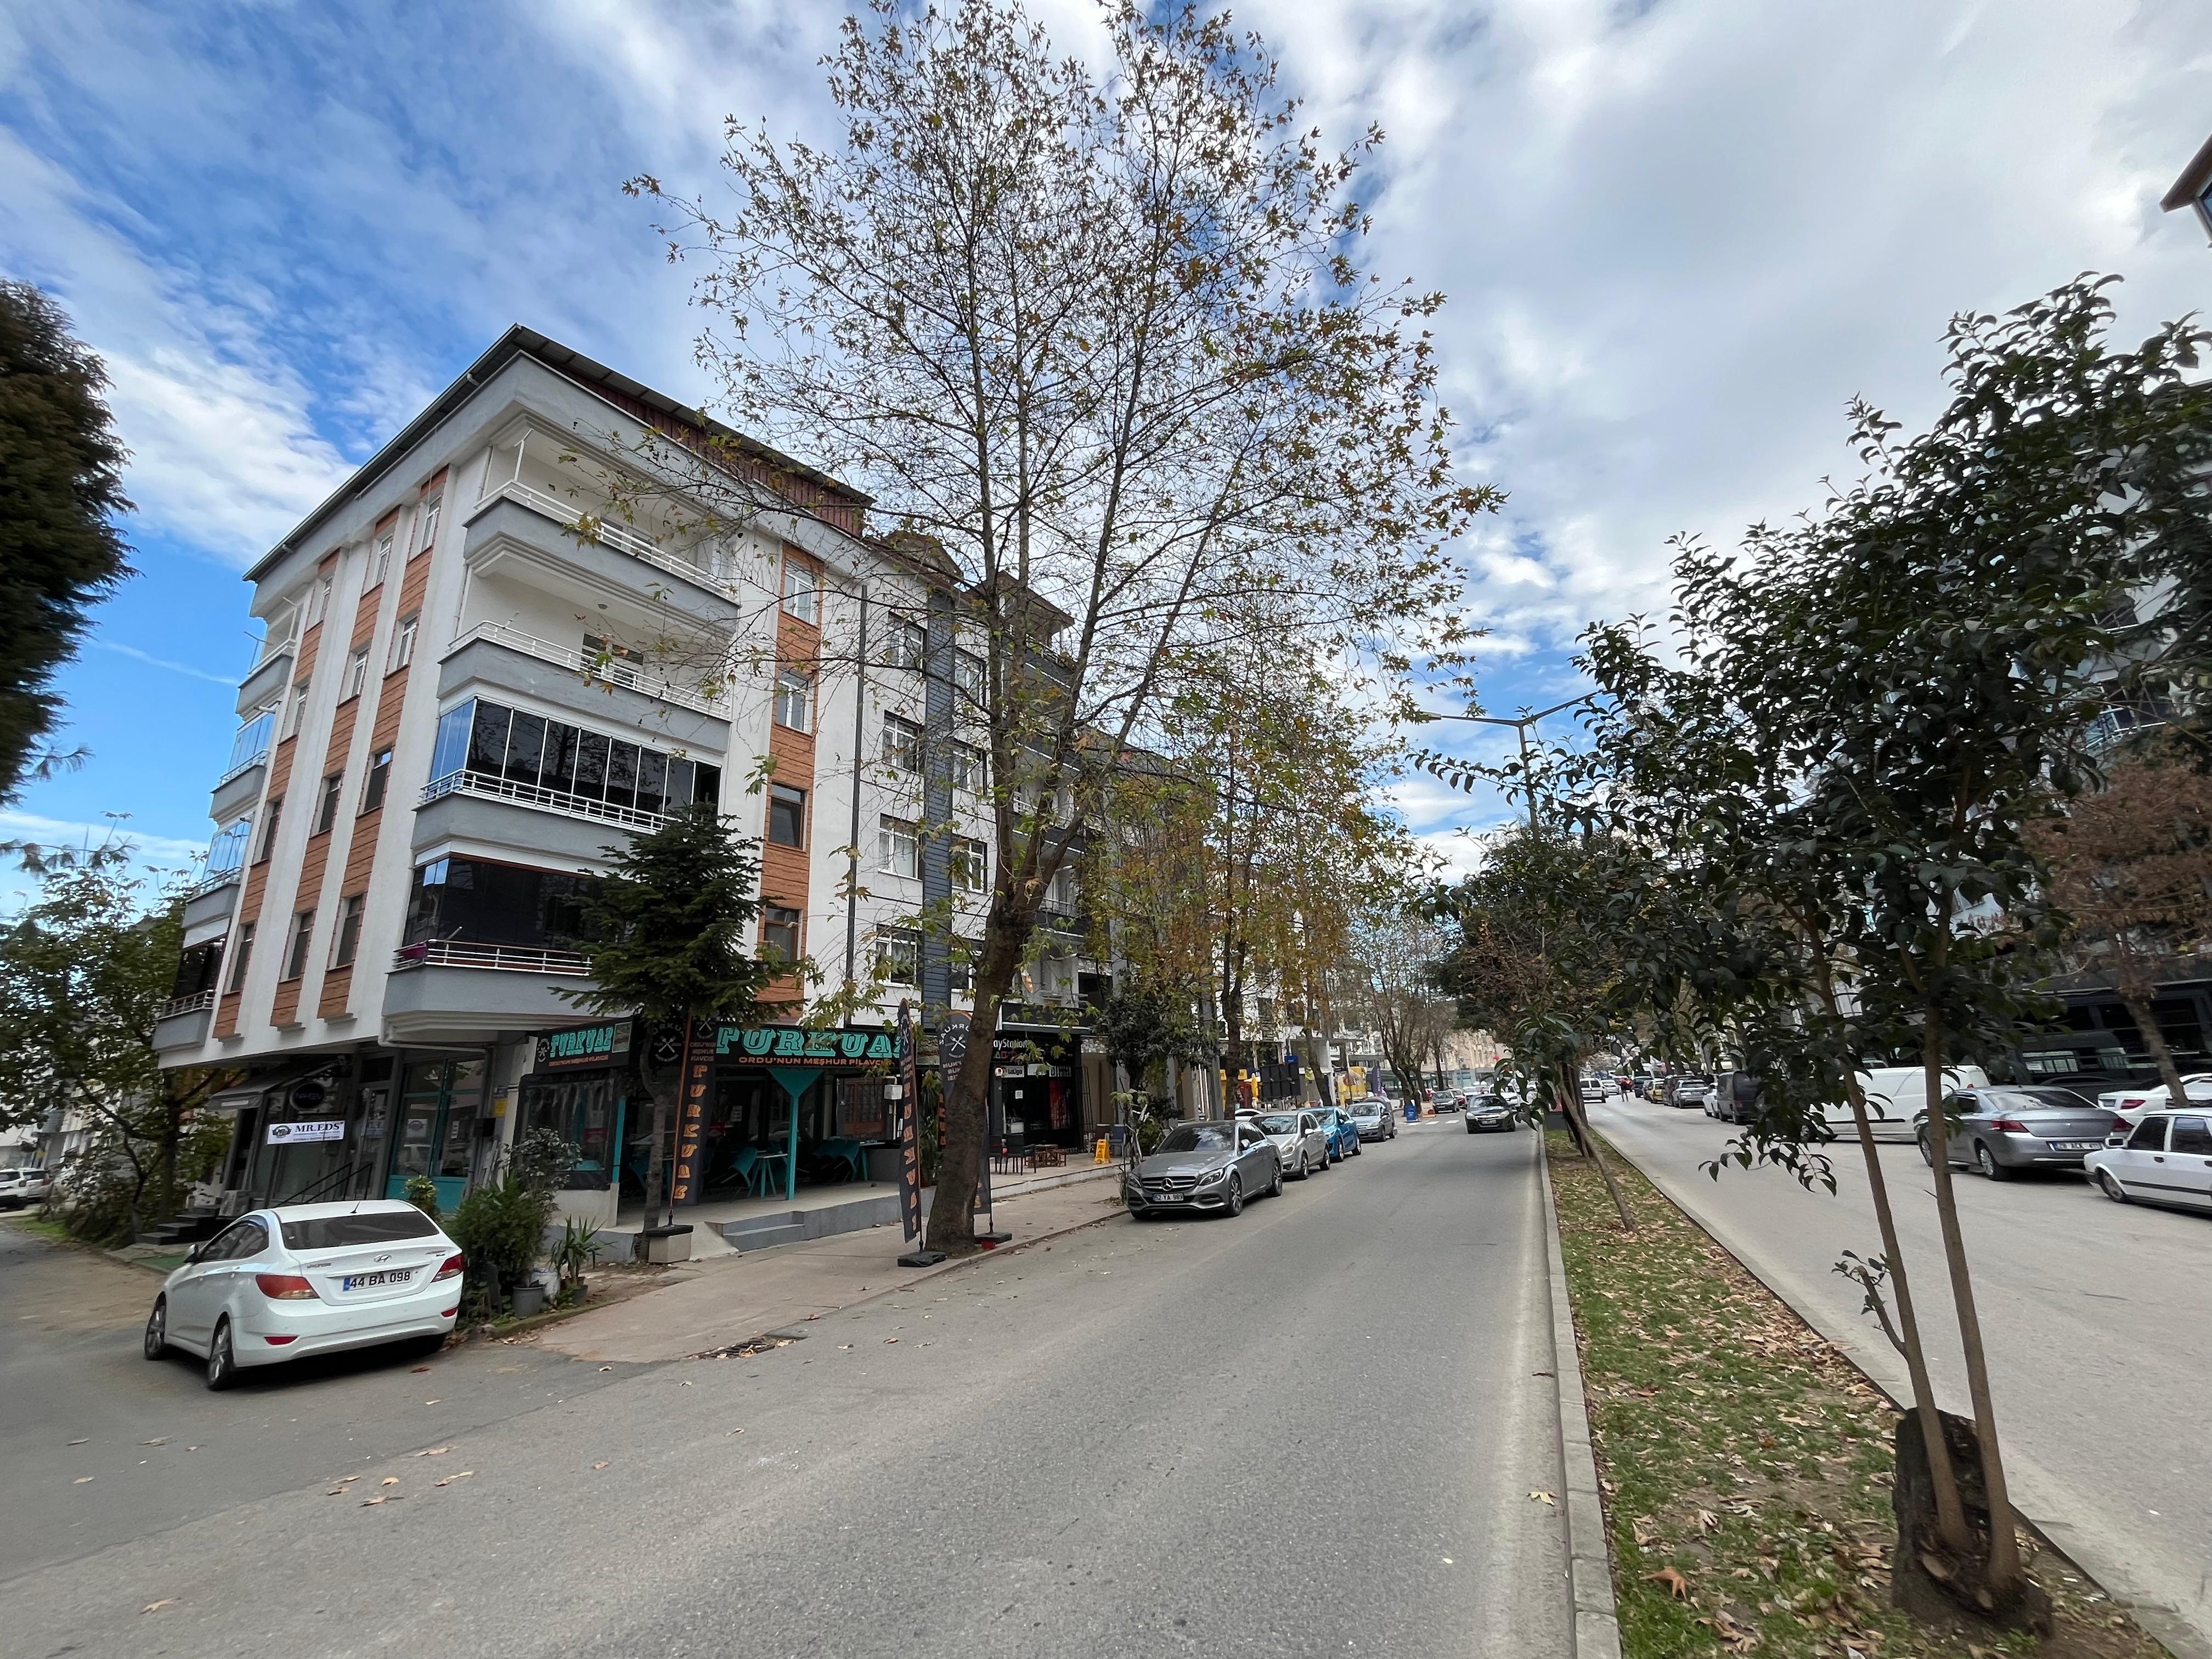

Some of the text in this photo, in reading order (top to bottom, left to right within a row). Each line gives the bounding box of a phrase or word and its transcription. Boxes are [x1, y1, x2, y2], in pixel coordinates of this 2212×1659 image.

[550, 1026, 613, 1058] TURKUAZ
[716, 1027, 900, 1058] TURKUA
[738, 1056, 801, 1064] ORDU'NUN
[803, 1058, 847, 1066] MEŞHUR
[350, 1271, 410, 1288] 44 BA 098
